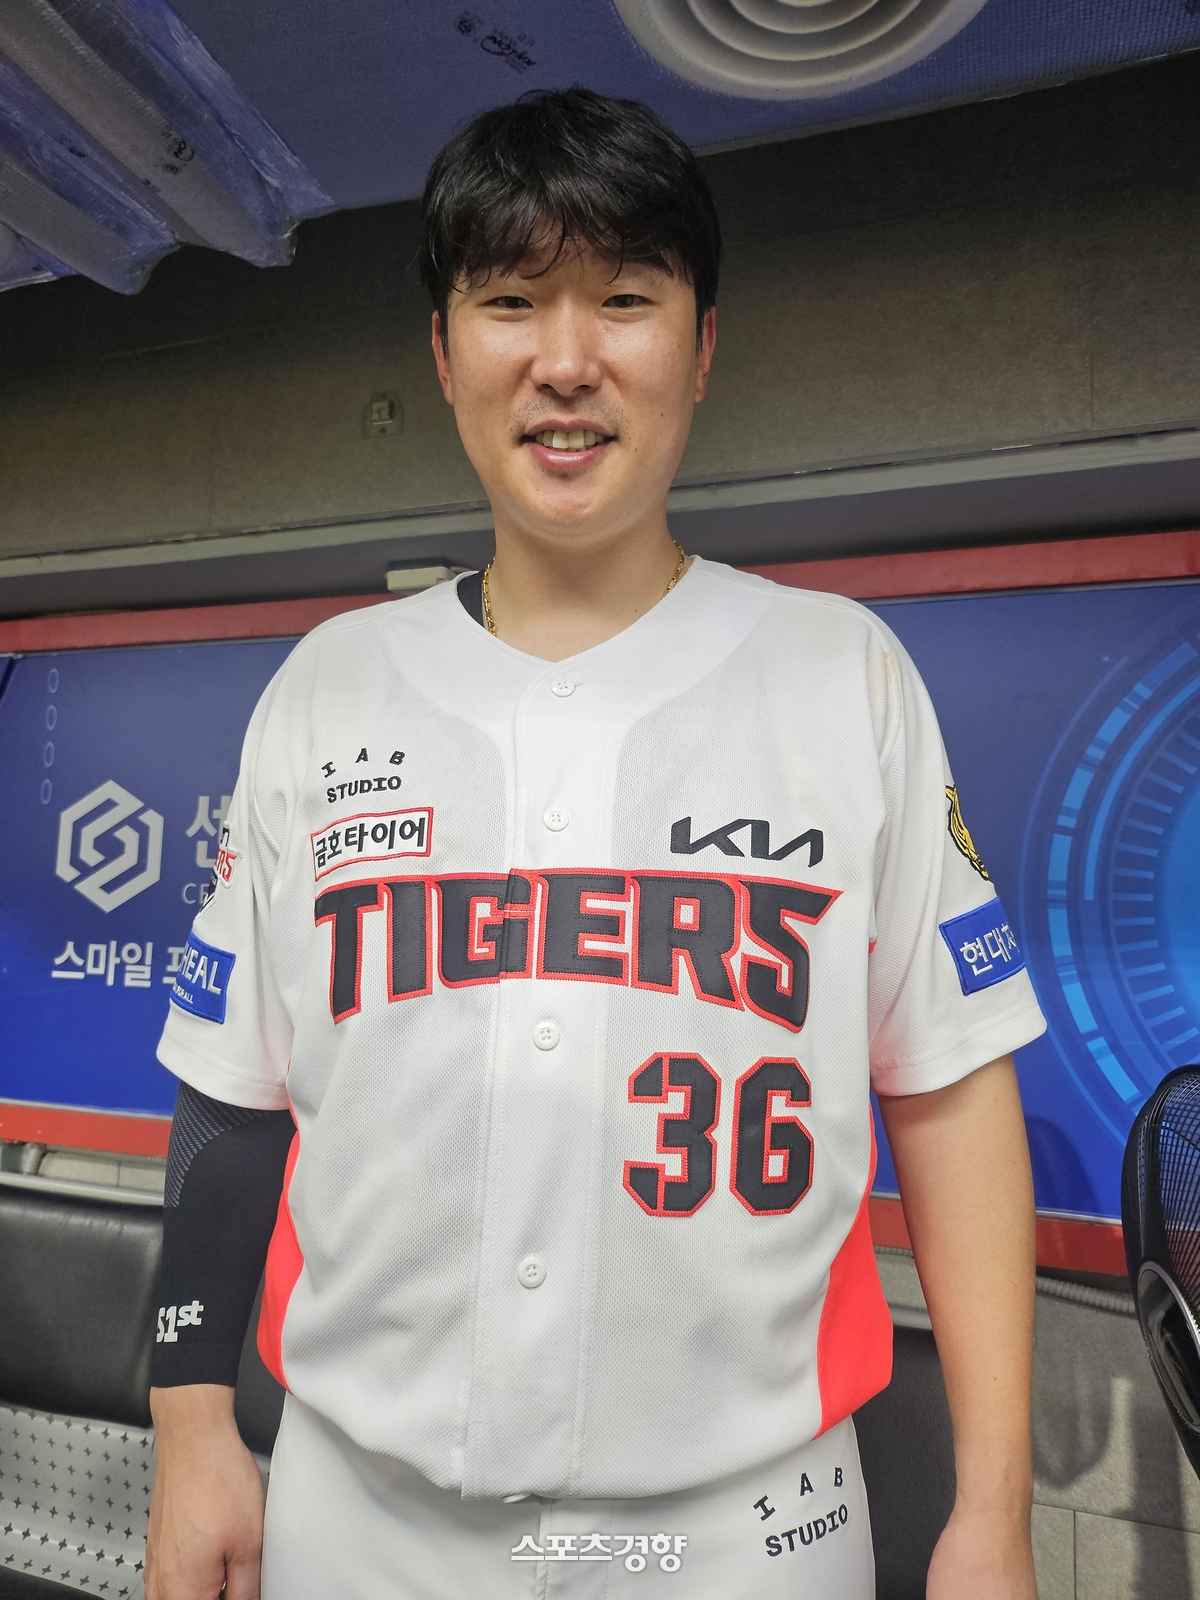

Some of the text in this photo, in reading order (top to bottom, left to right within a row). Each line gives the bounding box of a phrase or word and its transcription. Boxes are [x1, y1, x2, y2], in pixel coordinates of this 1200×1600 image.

[326, 775, 402, 804] STUDIO
[314, 817, 426, 869] 금호타이어
[51, 940, 154, 988] 스마일
[314, 868, 844, 1034] TIGERS
[622, 1051, 815, 1218] 36
[764, 1504, 849, 1558] STUDIO
